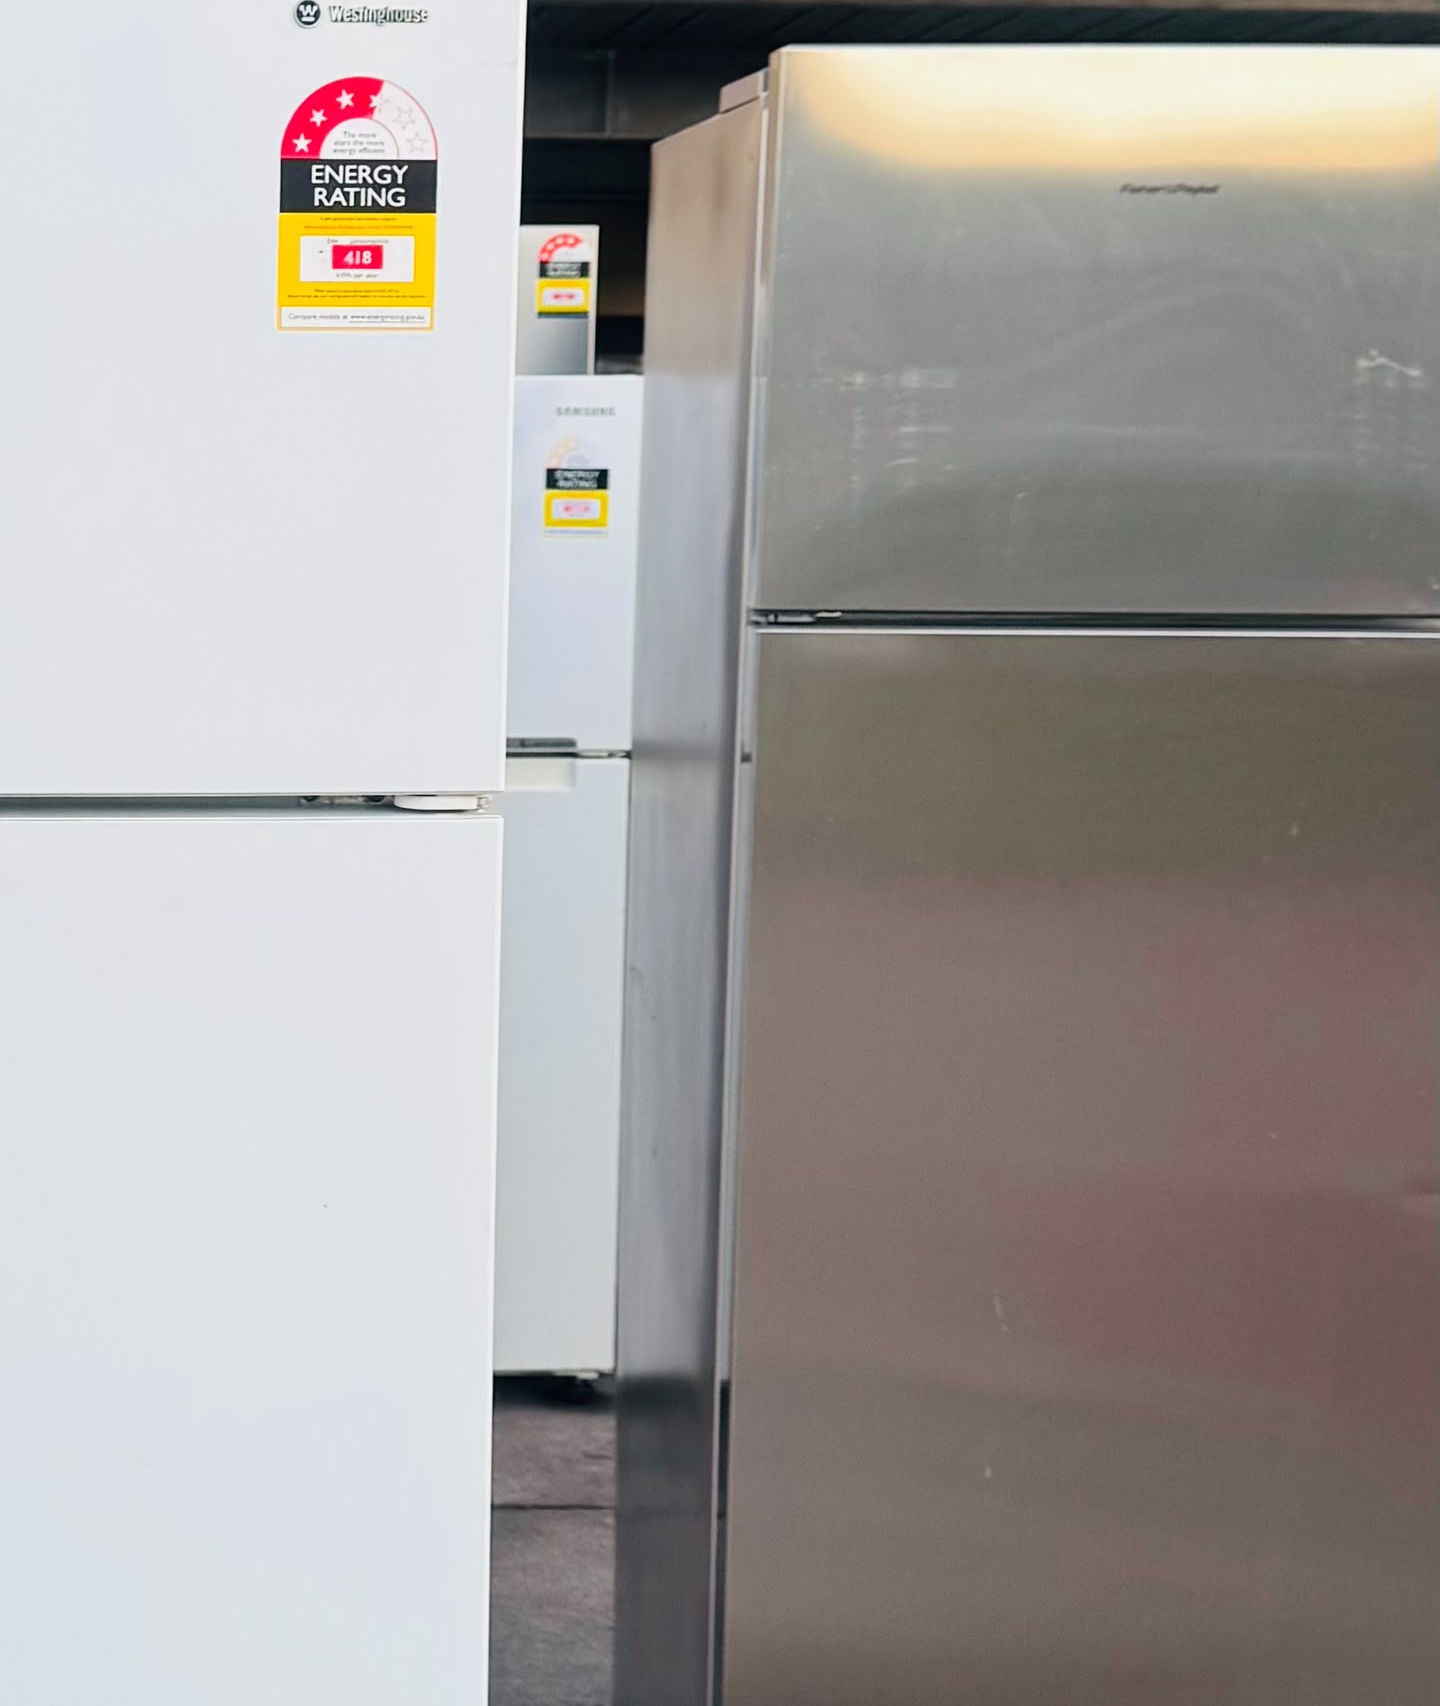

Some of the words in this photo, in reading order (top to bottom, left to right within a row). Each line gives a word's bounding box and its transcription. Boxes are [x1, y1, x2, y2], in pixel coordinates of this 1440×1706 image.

[328, 5, 429, 26] Westinghouse
[310, 164, 408, 184] ENERGY
[313, 187, 406, 207] RATING
[343, 250, 372, 265] 418
